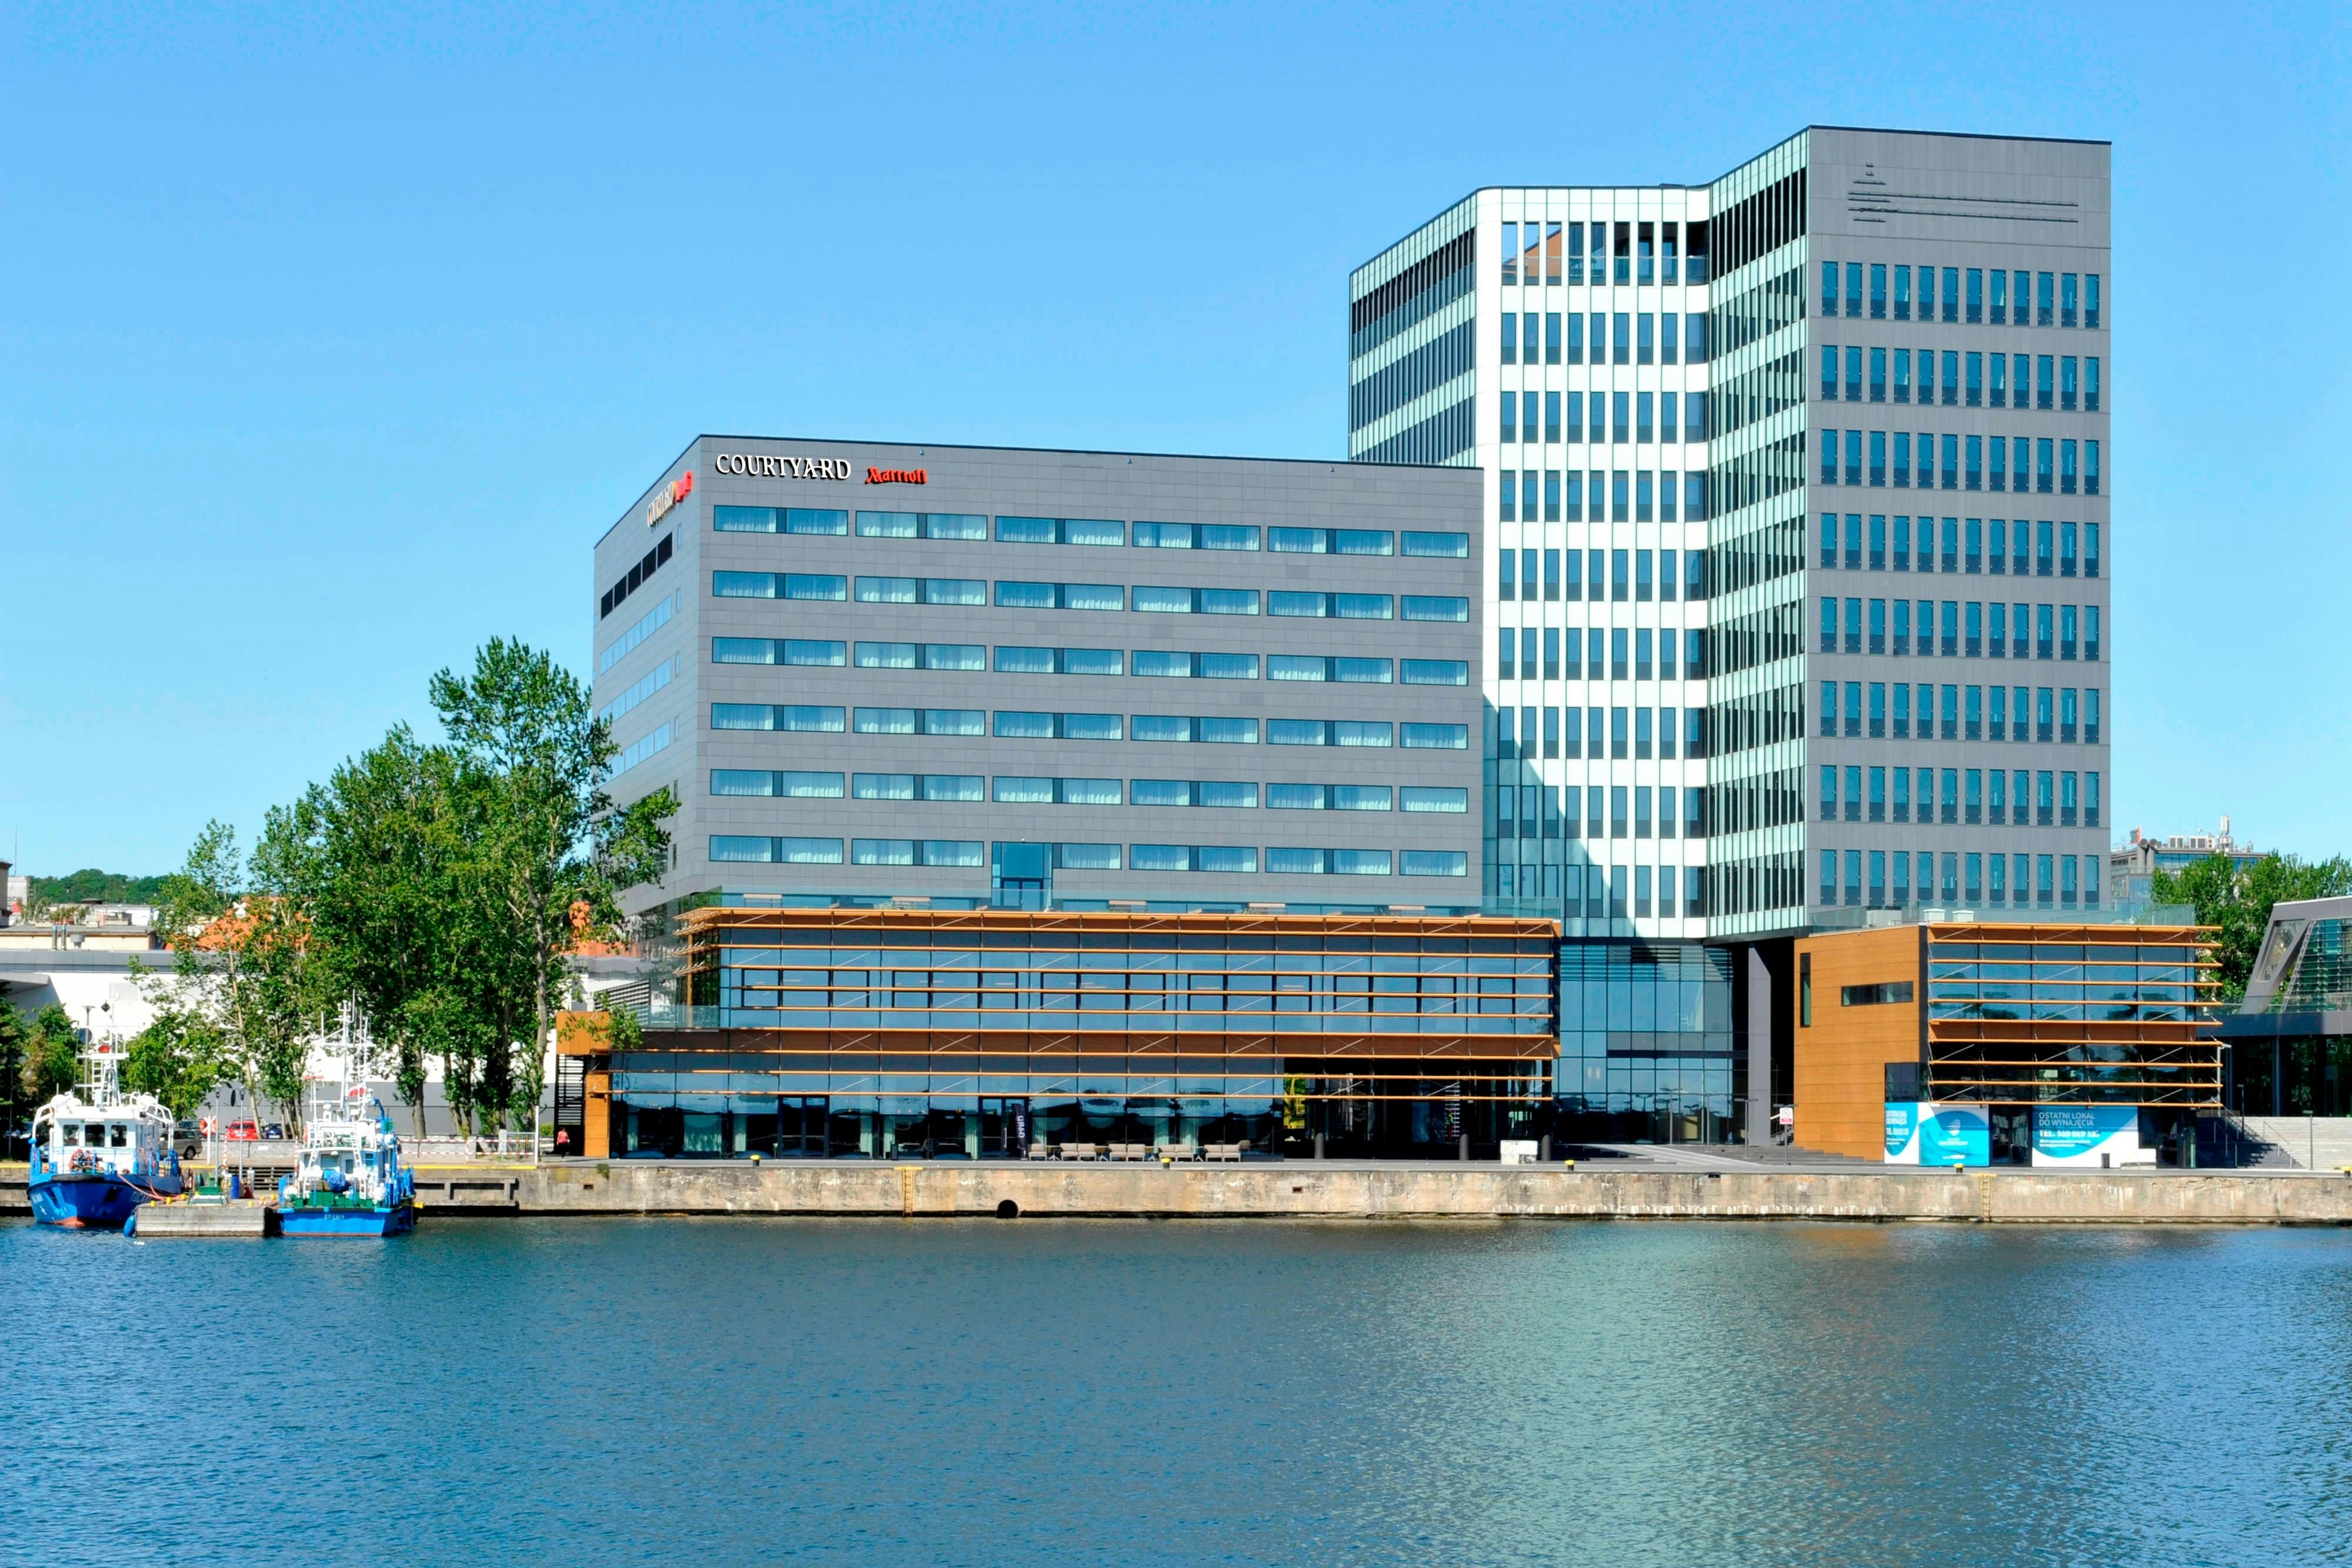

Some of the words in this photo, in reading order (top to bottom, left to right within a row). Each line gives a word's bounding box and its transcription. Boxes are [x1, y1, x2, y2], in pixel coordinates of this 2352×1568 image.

[716, 453, 851, 480] COURTYARD
[864, 466, 927, 484] Marriott
[2052, 1119, 2094, 1128] WYNAJĘCIA
